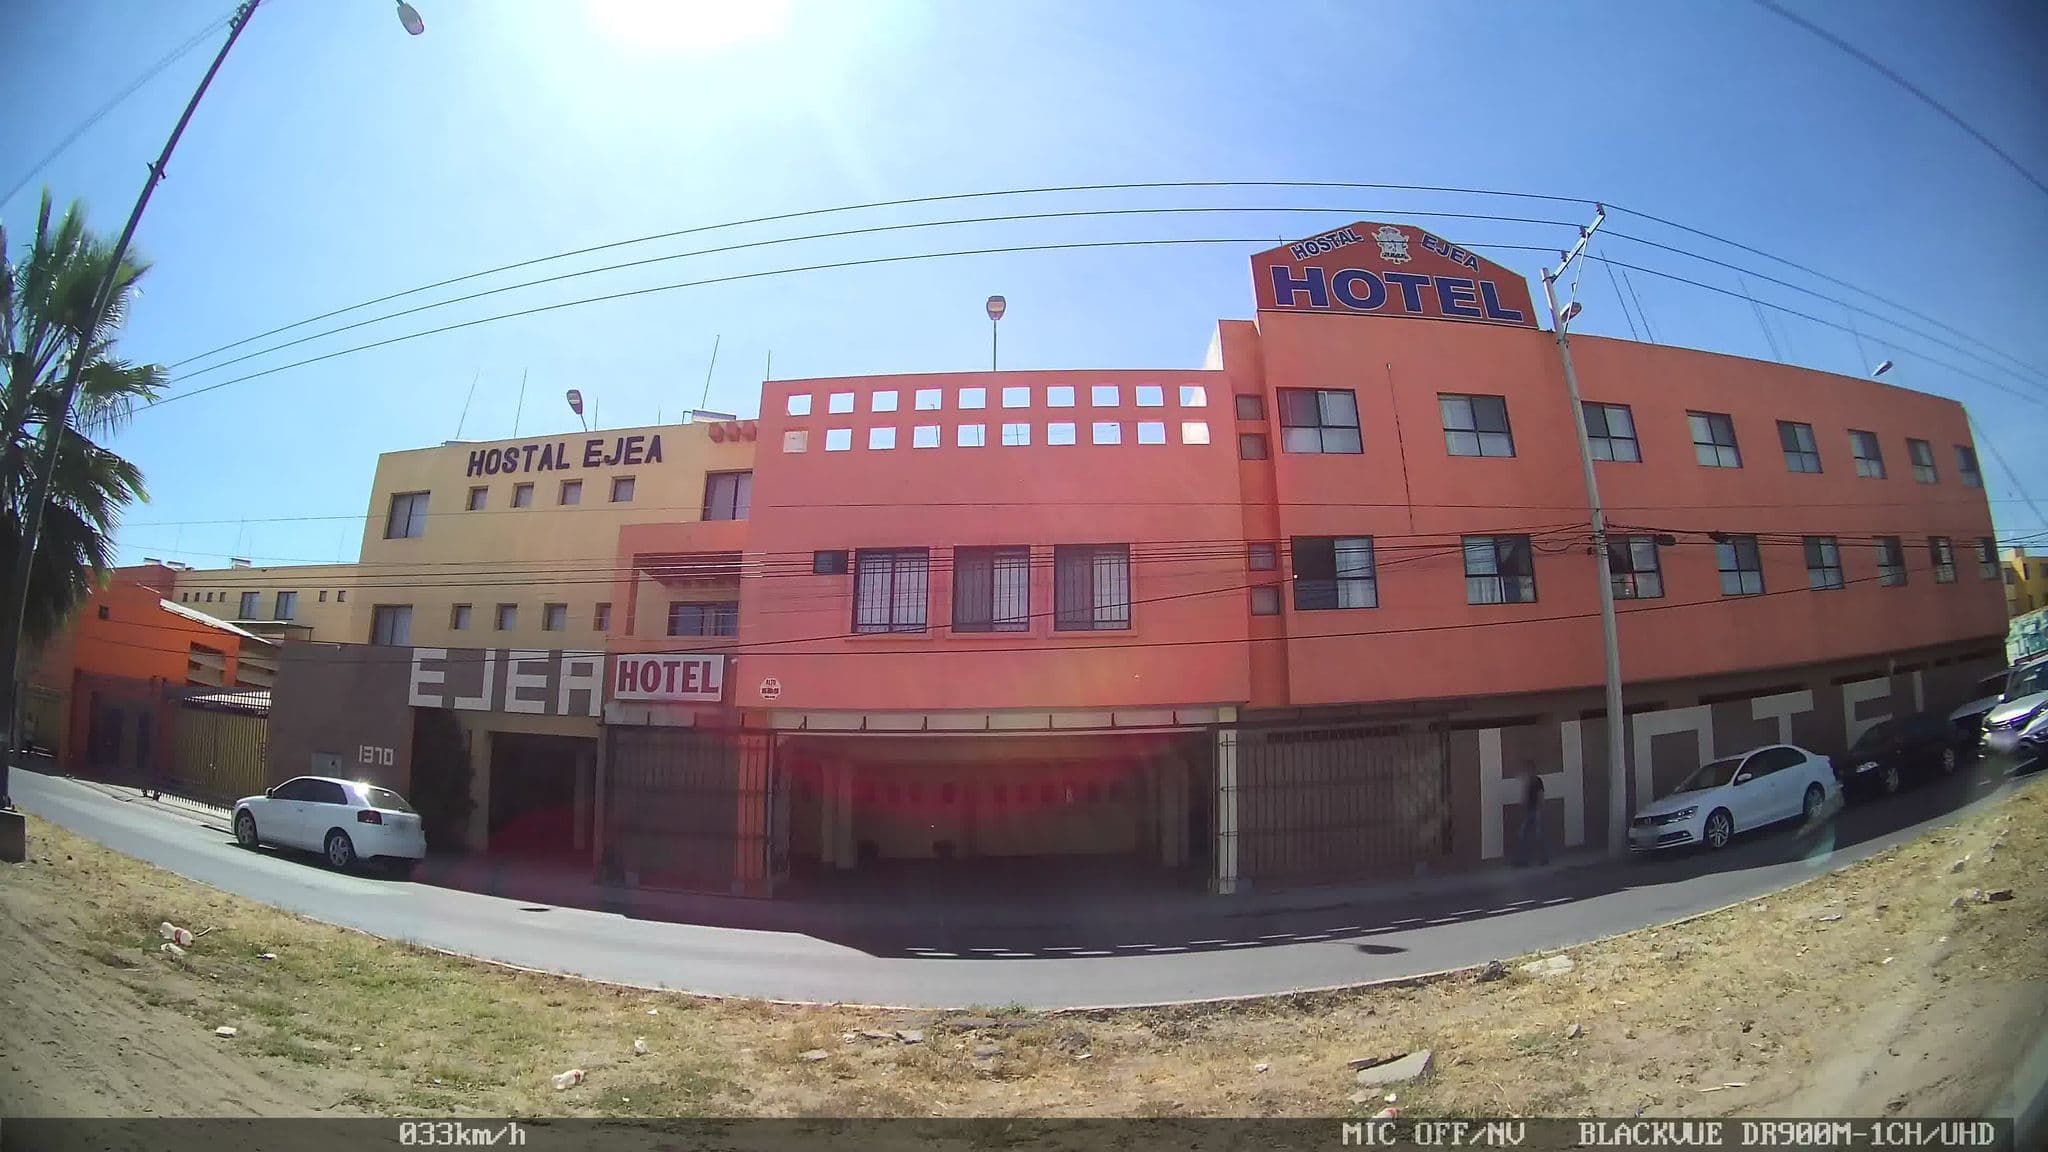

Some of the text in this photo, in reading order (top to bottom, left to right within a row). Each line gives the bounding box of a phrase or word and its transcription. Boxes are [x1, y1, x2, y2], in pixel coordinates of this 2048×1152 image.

[1290, 227, 1480, 273] HOSTAL EJEA
[1270, 264, 1525, 323] HOTEL
[466, 434, 663, 477] HOSTAL EJEA
[408, 648, 605, 717] EJEA
[617, 660, 719, 694] HOTEL
[358, 744, 394, 767] 1370
